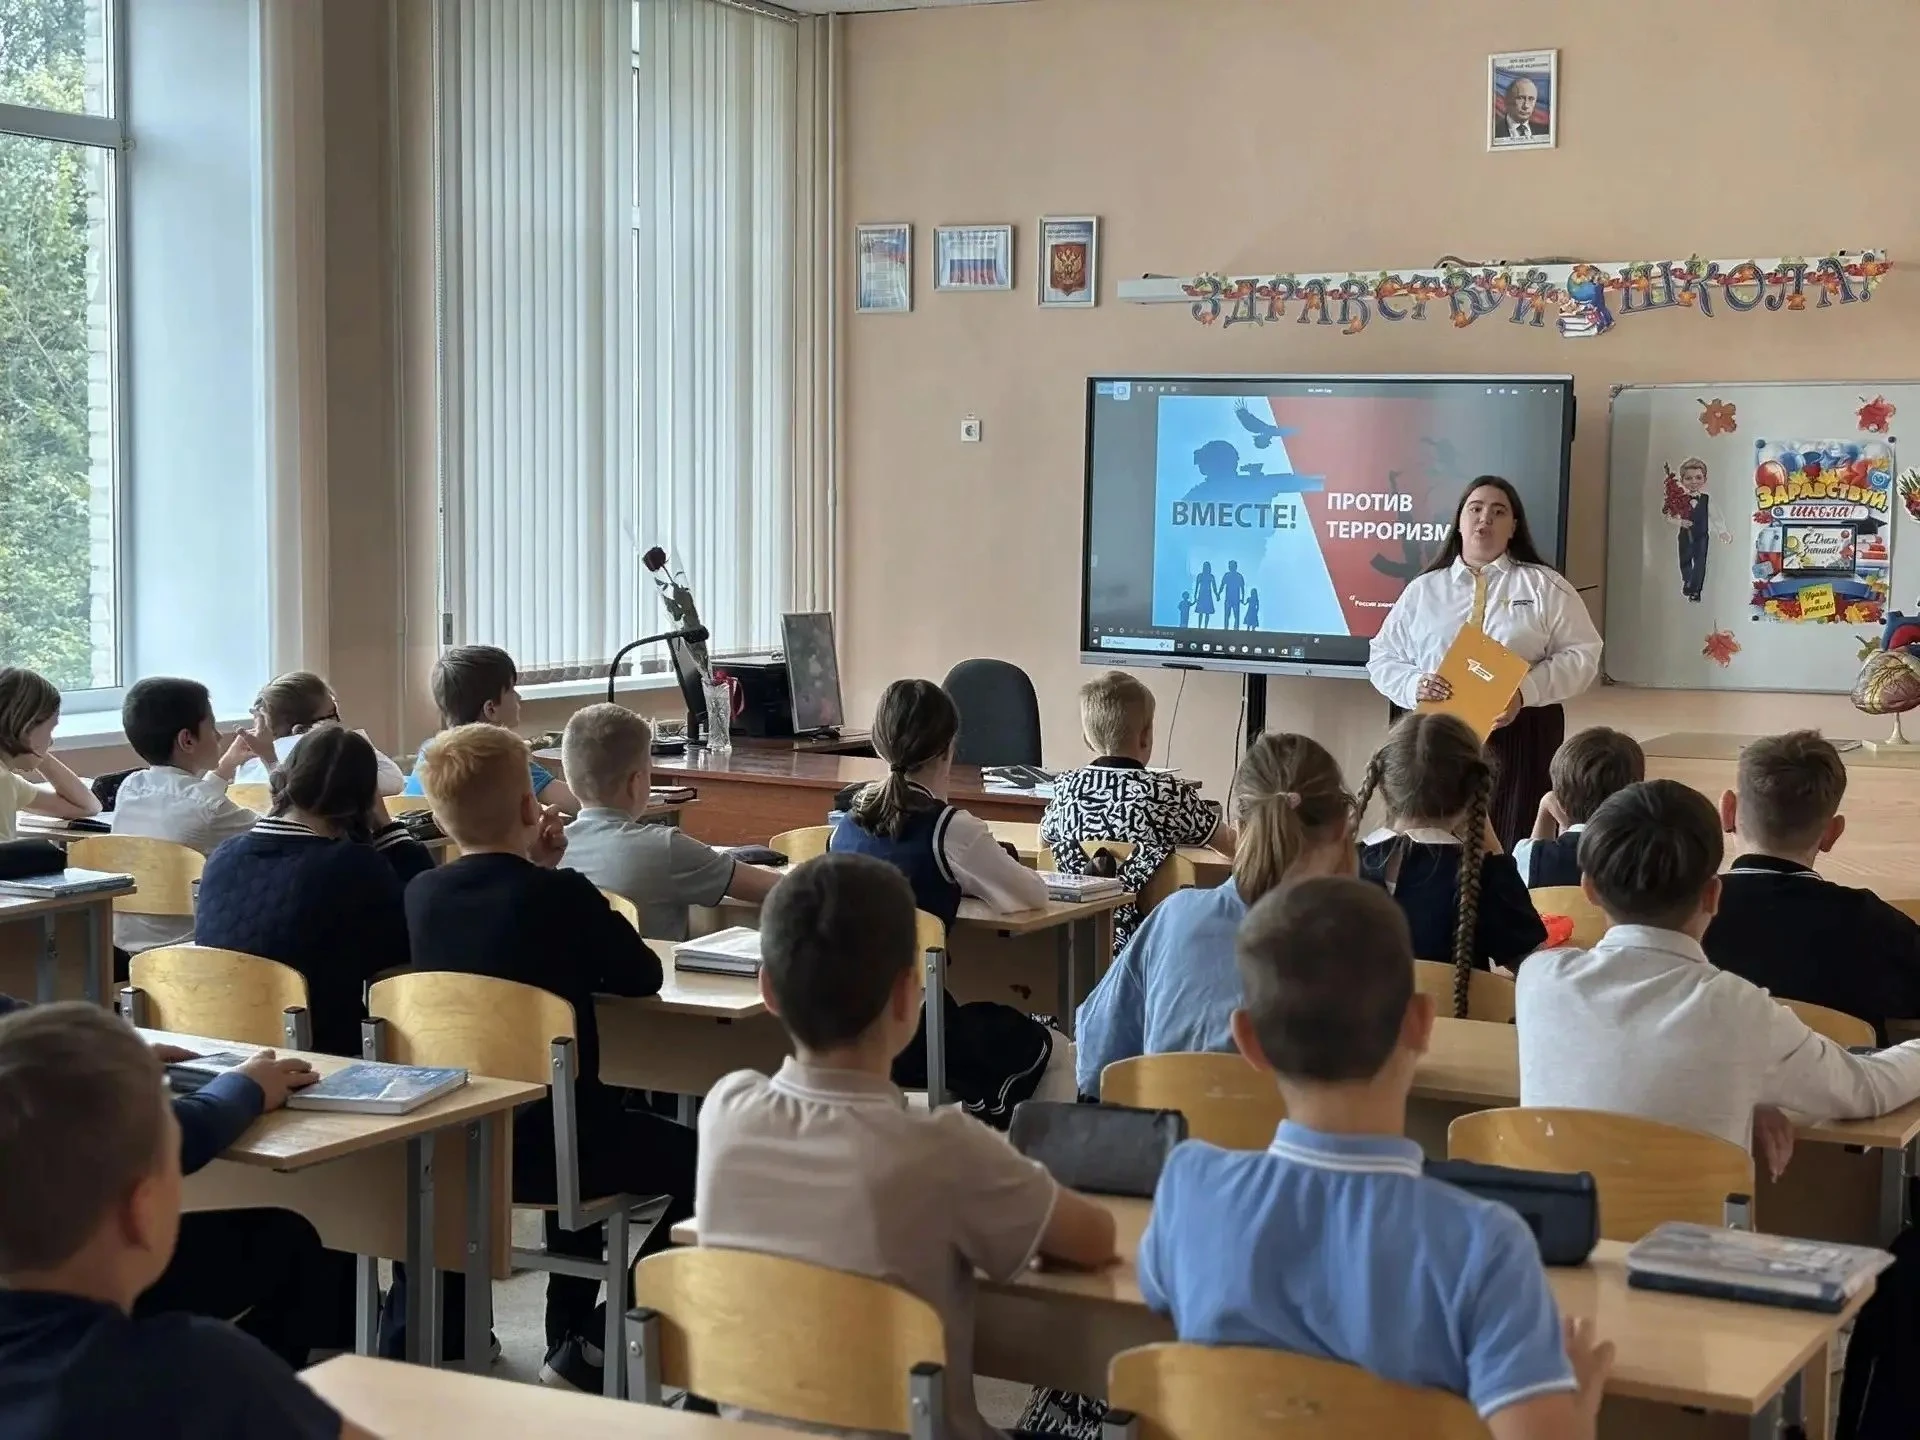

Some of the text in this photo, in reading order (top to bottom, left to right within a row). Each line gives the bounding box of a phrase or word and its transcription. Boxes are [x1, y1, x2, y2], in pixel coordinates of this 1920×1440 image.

[1619, 252, 1877, 318] ШКОЛА!
[1172, 501, 1297, 529] ВМЕСТЕ!
[1327, 492, 1413, 512] ПРОТИВ
